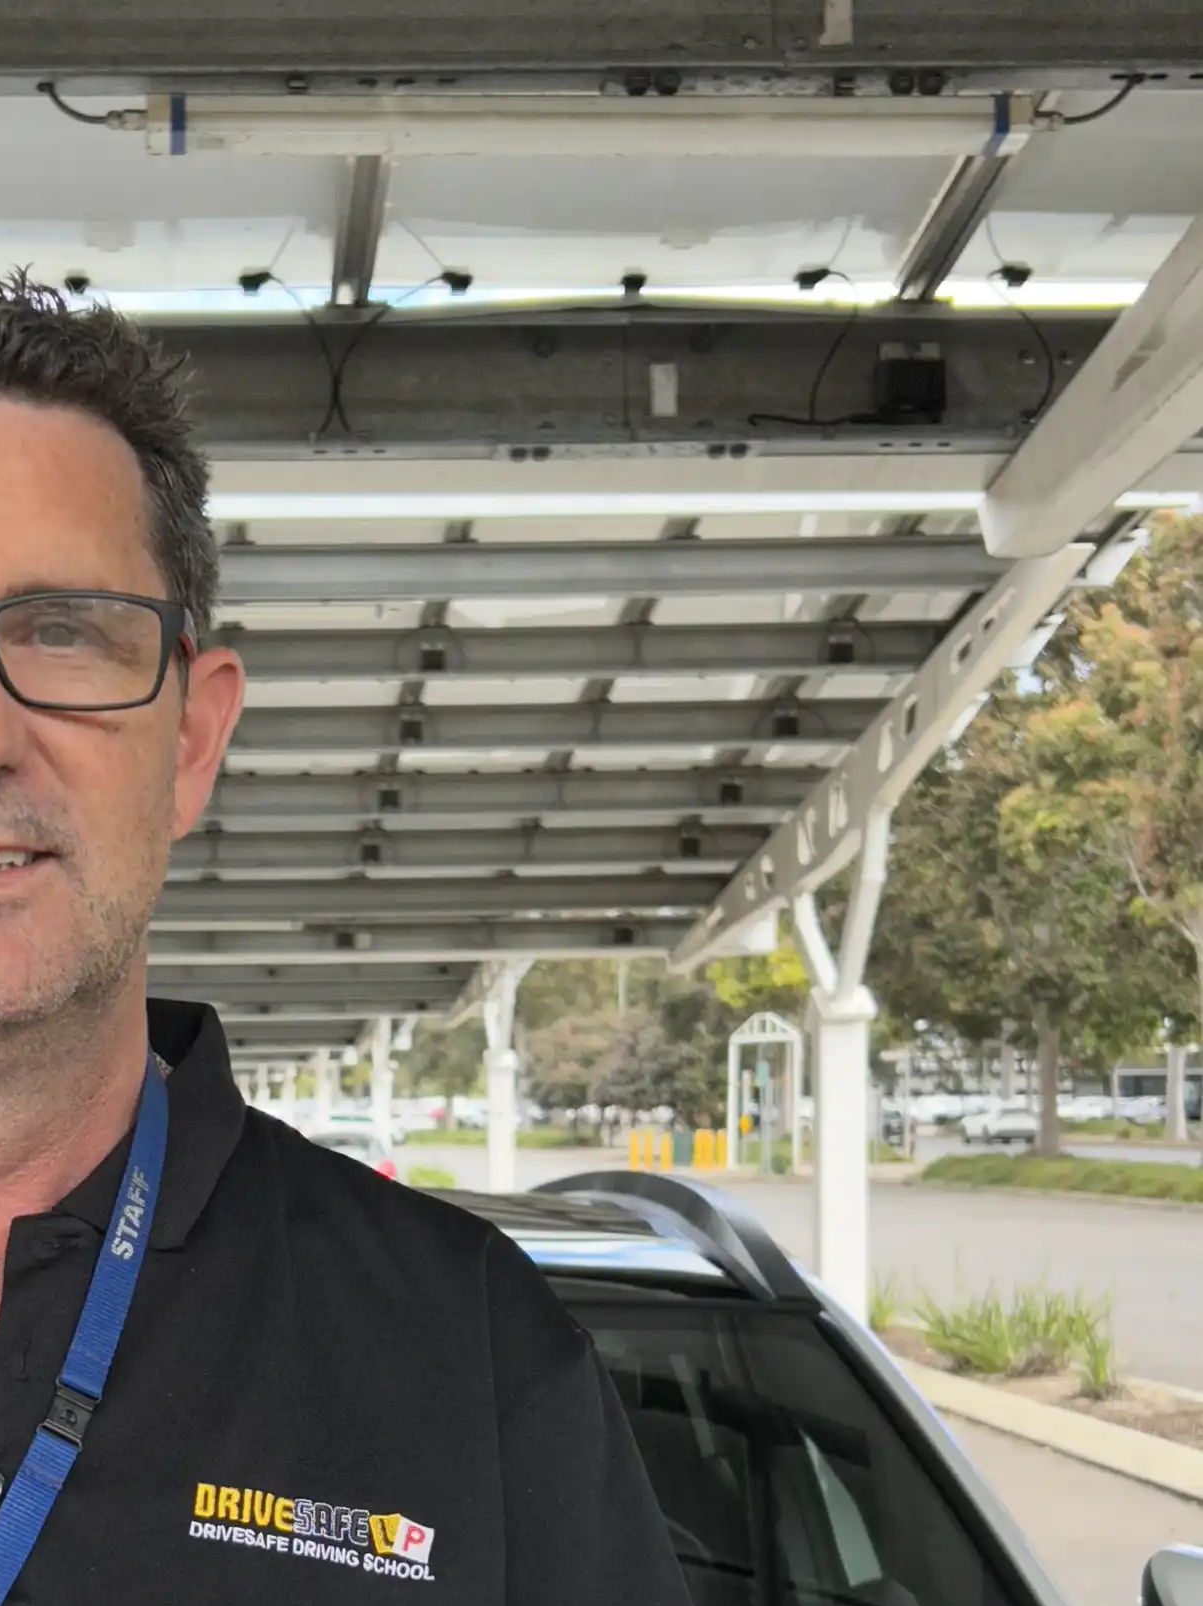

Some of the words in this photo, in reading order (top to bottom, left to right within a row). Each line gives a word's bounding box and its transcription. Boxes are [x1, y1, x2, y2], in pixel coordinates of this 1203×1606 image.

[110, 1166, 148, 1260] STAFF
[189, 1521, 289, 1553] DRIVESAFE
[292, 1539, 360, 1567] DRIVING
[363, 1552, 435, 1581] SCHOOL
[194, 1482, 370, 1546] DRIVESAFE
[402, 1525, 427, 1553] P
